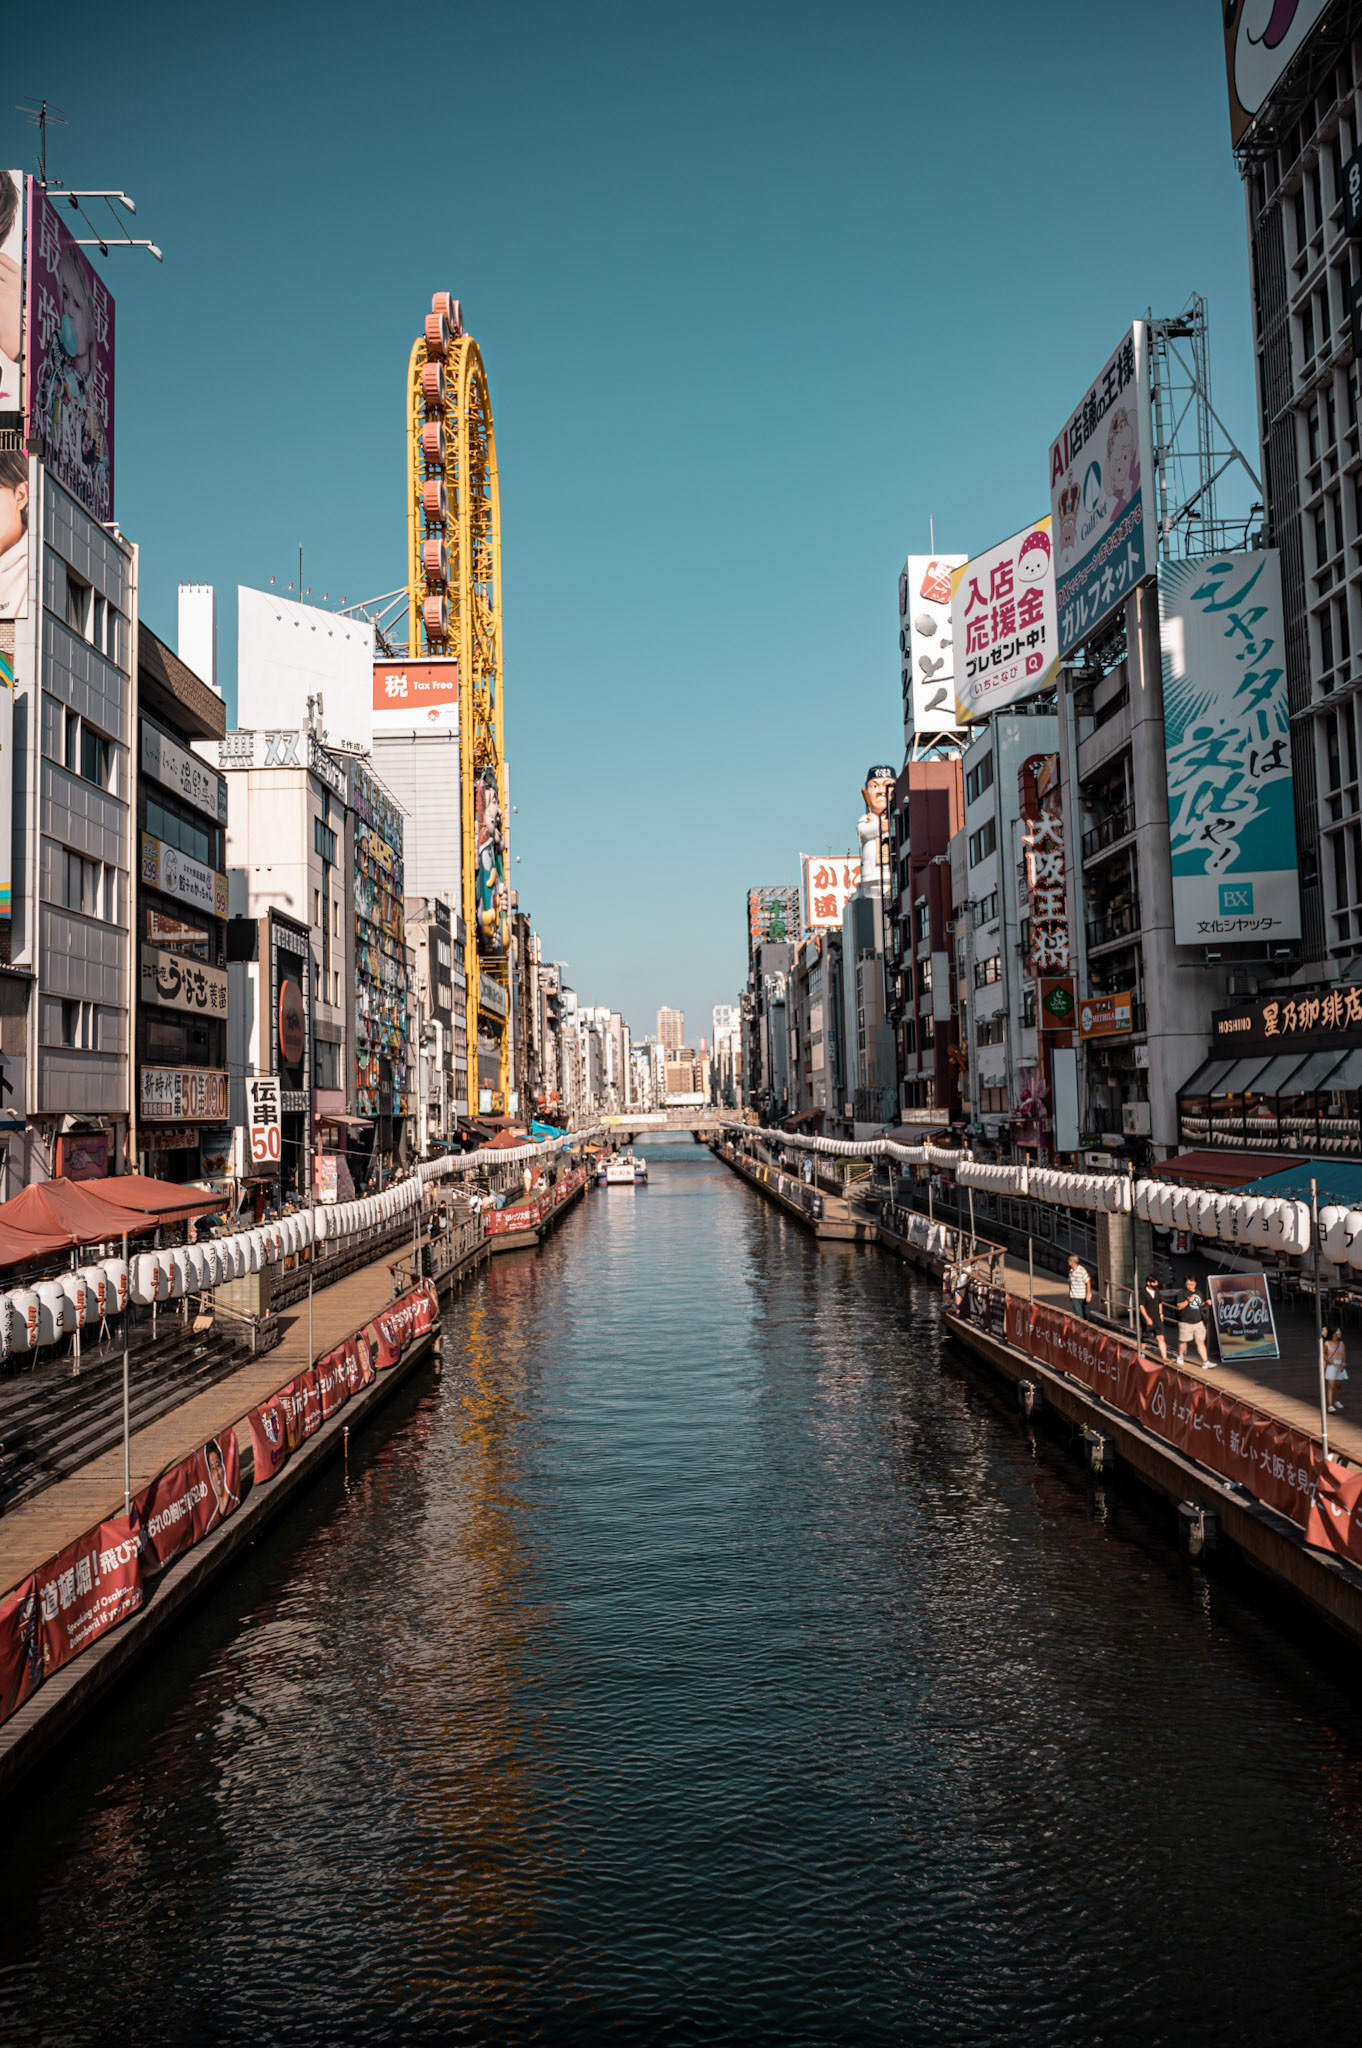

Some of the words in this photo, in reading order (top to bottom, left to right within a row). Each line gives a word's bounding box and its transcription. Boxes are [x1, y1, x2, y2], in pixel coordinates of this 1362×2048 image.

[38, 198, 61, 349] 最強
[92, 274, 109, 428] 最高
[1052, 338, 1134, 489] AI店舗の王様
[964, 558, 1014, 618] 入店
[1061, 541, 1140, 646] ガルフネット
[966, 587, 1044, 656] 応援金
[966, 625, 1046, 678] プレゼント中!
[385, 674, 408, 697] 税
[414, 681, 430, 690] Tax
[432, 681, 453, 689] Free
[974, 665, 1018, 694] いちこなび
[218, 731, 301, 768] 無双
[813, 865, 861, 890] かに
[1032, 812, 1069, 968] 大阪王将
[1223, 890, 1249, 908] BX
[156, 958, 208, 1008] うなぎ
[209, 982, 227, 1009] 菱富
[1093, 1013, 1115, 1022] MITHILA
[1218, 1017, 1251, 1034] HOSHINO
[1262, 987, 1362, 1037] 星乃珈琲店
[144, 1072, 173, 1101] 新時代
[182, 1075, 198, 1116] 50
[251, 1082, 278, 1126] 伝串
[252, 1127, 280, 1160] 50
[1218, 1296, 1269, 1325] Coca-Cola
[67, 1609, 93, 1635] Speaking
[93, 1600, 101, 1613] of
